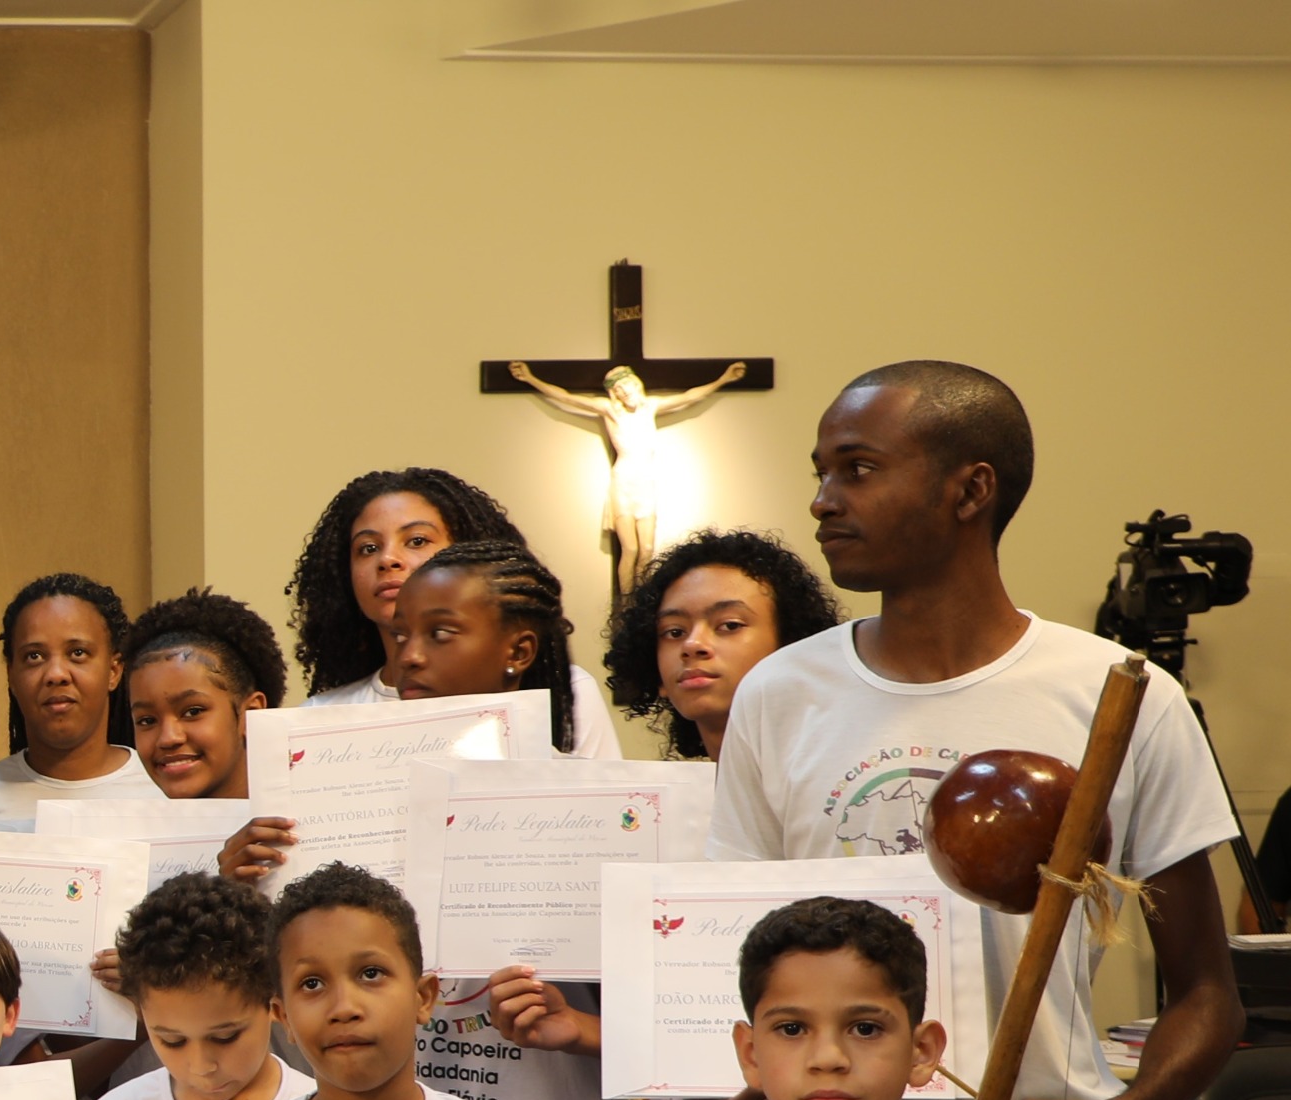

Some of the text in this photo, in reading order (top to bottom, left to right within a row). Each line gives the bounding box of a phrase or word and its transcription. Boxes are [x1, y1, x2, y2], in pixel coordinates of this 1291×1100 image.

[824, 745, 933, 816] ASSOCIAÇÃO DE
[460, 809, 606, 837] Poder Legislativo
[449, 880, 562, 894] LUIZ FELIPE SOUZA
[30, 941, 82, 952] ABRANTES
[431, 1037, 522, 1060] Capoeira
[416, 1061, 499, 1085] idadania
